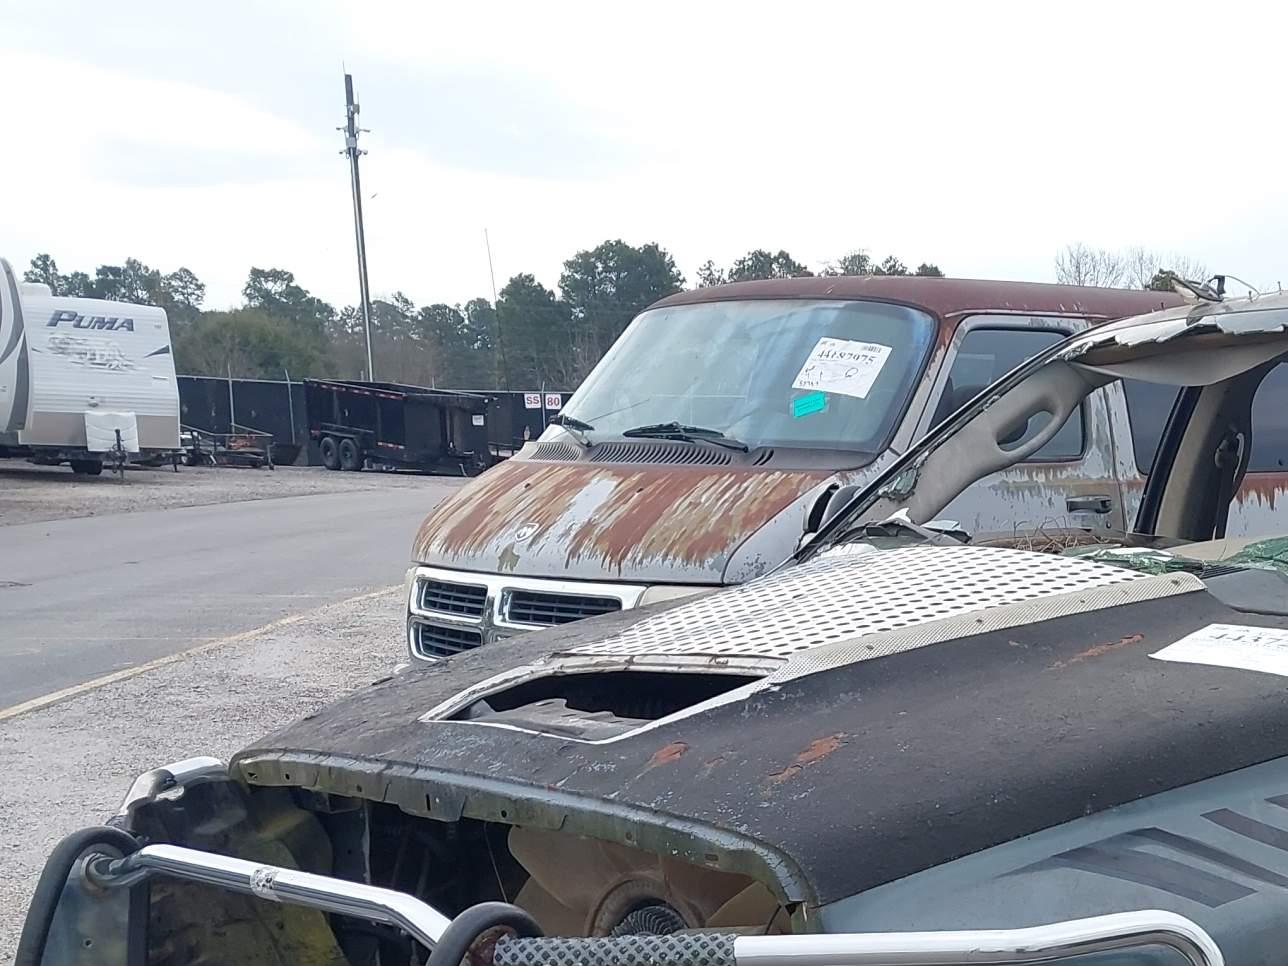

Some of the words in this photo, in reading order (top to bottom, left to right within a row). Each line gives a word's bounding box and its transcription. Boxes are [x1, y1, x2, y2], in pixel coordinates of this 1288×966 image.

[46, 309, 135, 332] PUMA
[525, 396, 540, 405] SS
[546, 396, 560, 406] 80
